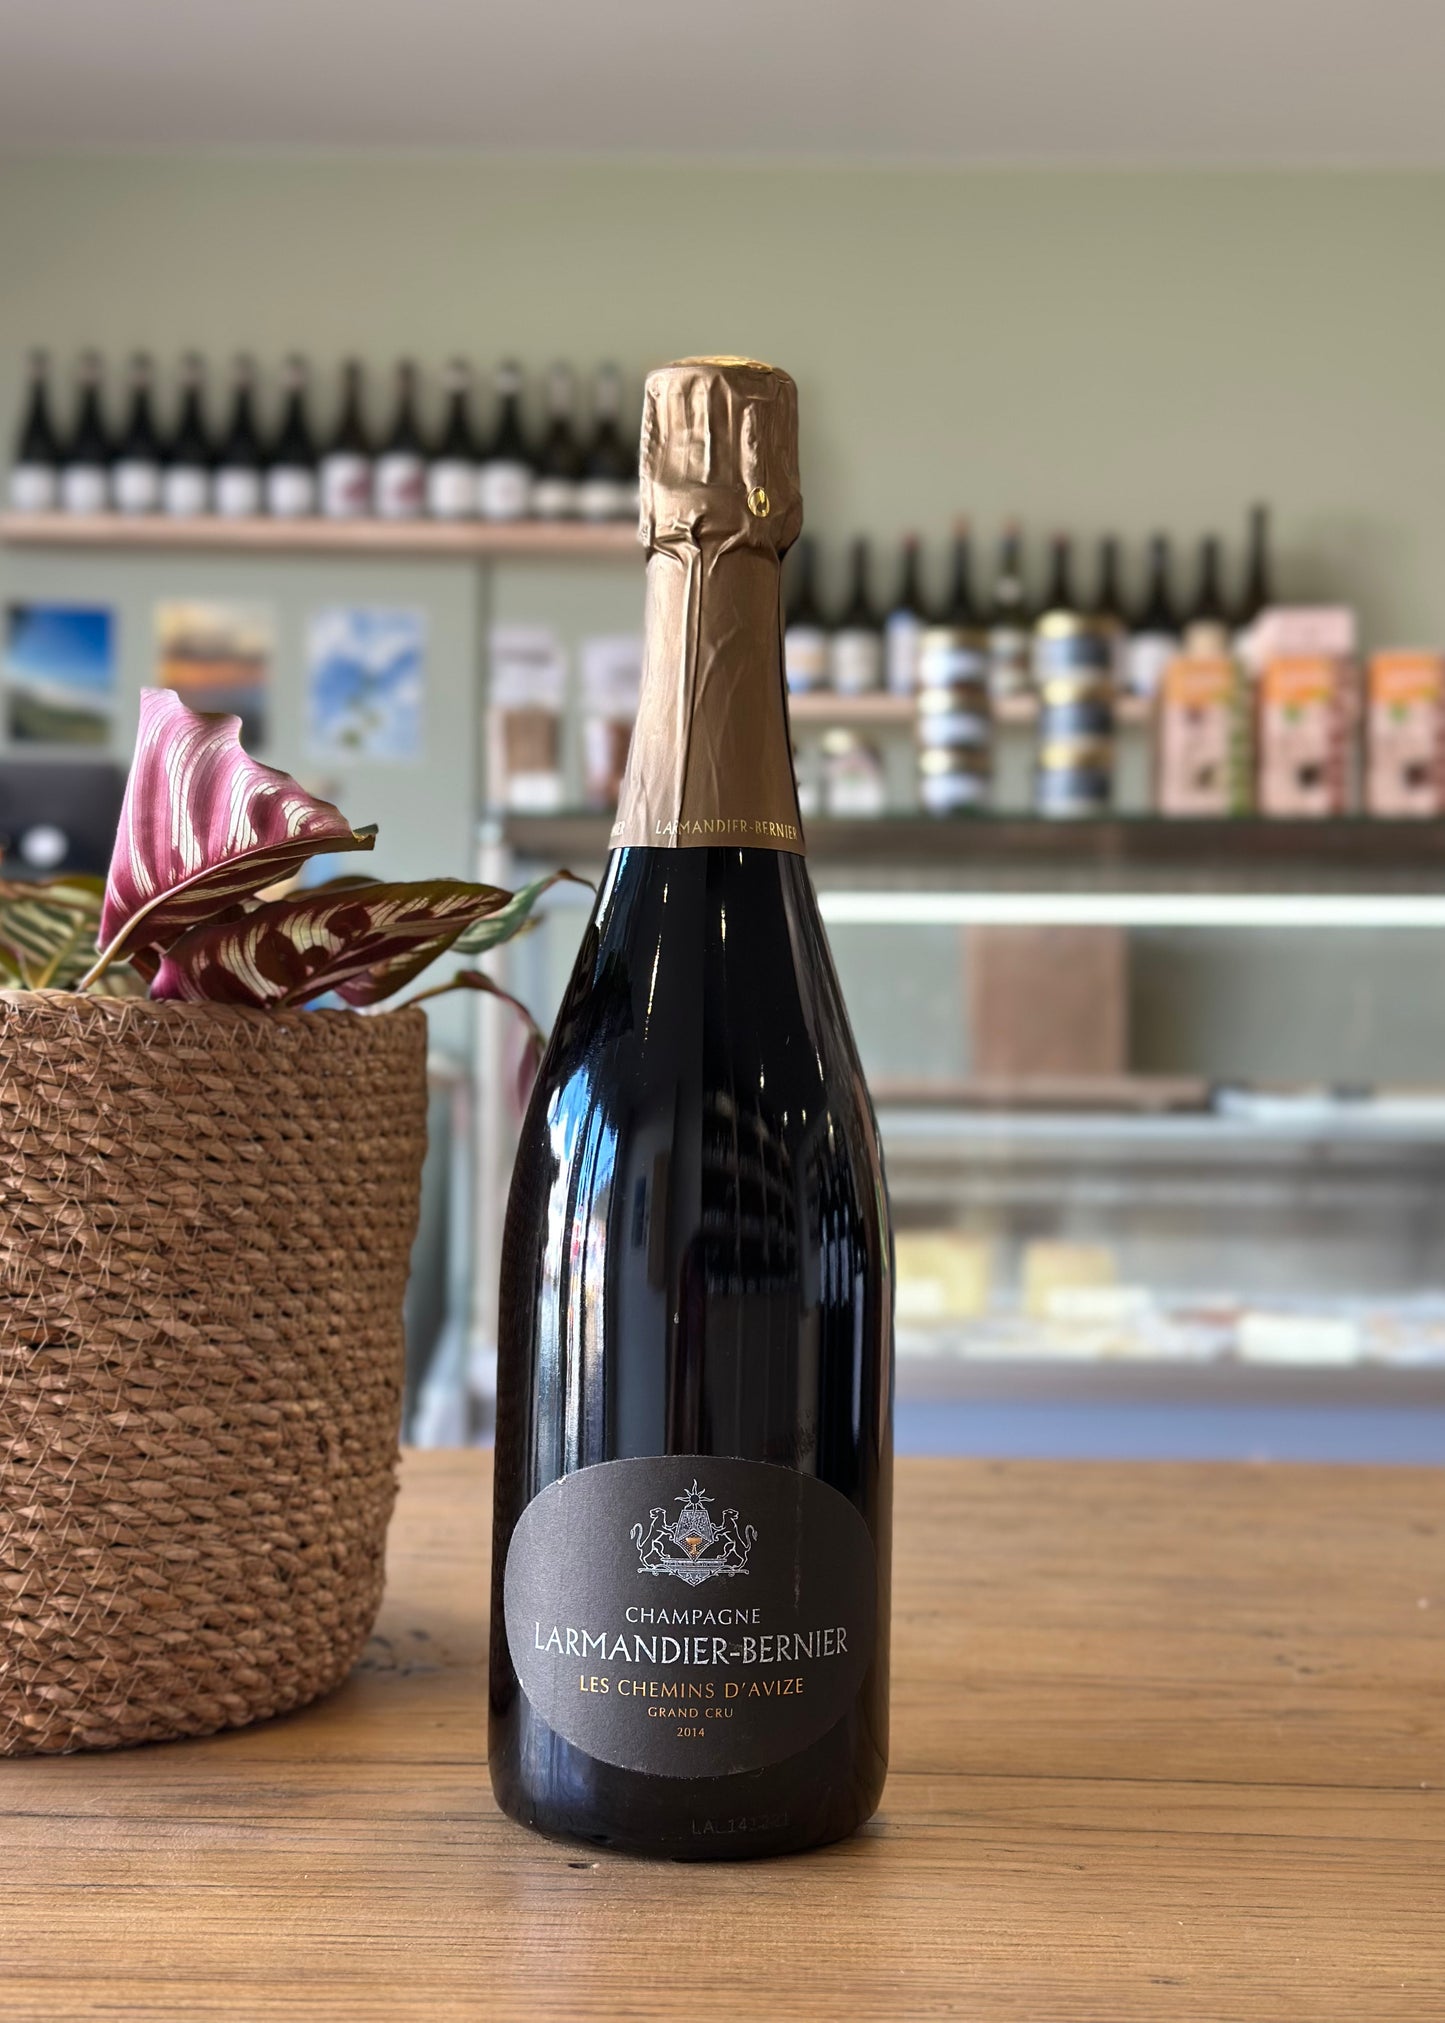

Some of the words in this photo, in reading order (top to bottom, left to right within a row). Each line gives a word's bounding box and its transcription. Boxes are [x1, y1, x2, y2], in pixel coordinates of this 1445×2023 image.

[655, 819, 798, 841] LARMANDIER-BERNIER
[625, 1606, 761, 1625] CHAMPAGNE
[534, 1621, 848, 1665] LARMANDIER-BERNIER
[579, 1675, 610, 1694] LES
[617, 1678, 715, 1699] CHEMINS
[725, 1677, 804, 1698] D'AVIZE
[647, 1706, 699, 1719] GRAND
[705, 1707, 734, 1719] CRU
[676, 1726, 705, 1738] 2014
